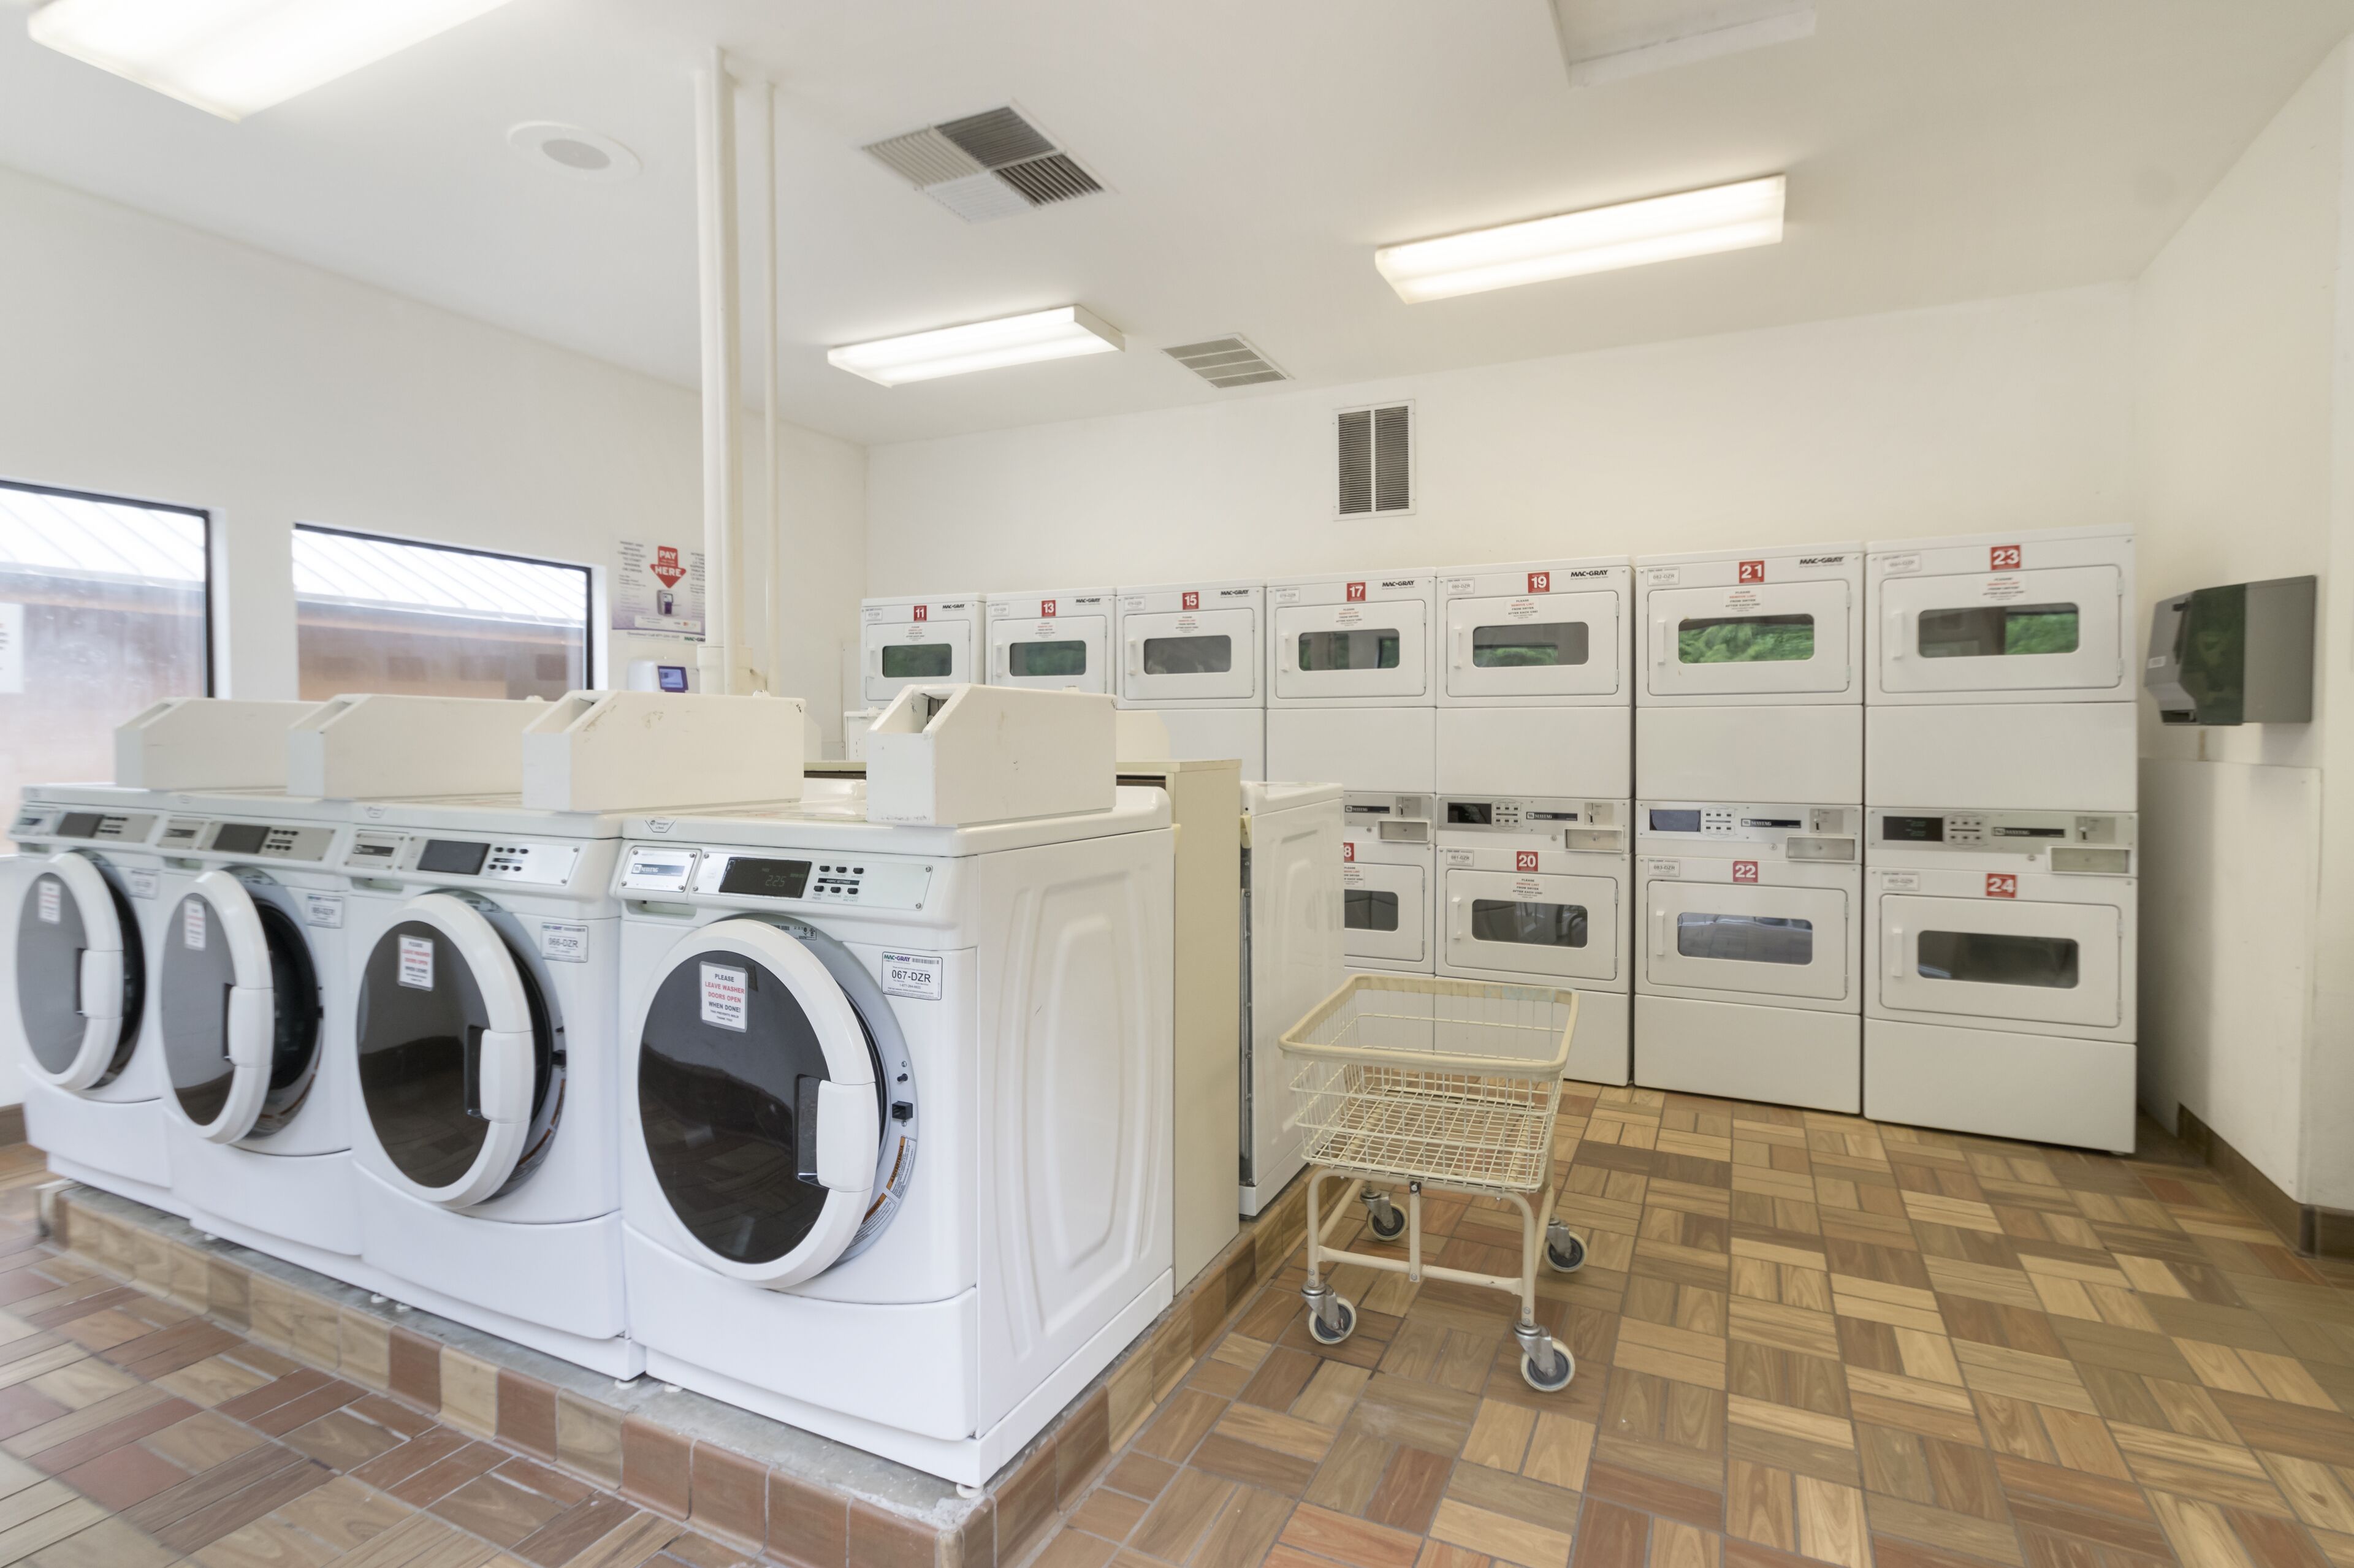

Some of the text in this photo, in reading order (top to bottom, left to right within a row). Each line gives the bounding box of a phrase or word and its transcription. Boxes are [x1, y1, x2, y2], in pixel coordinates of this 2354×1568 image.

[660, 550, 676, 559] PAY
[1992, 549, 2019, 565] 23
[655, 565, 682, 577] HERE
[1741, 564, 1762, 579] 21
[1531, 576, 1547, 588] 19
[1349, 586, 1364, 598] 17
[1184, 595, 1197, 606] 15
[915, 608, 924, 618] 11
[1043, 603, 1054, 613] 13
[1344, 846, 1352, 858] 8
[1518, 854, 1536, 867] 20
[1735, 865, 1756, 878] 22
[1988, 878, 2016, 893] 24
[715, 973, 734, 982] PLEASE
[892, 970, 931, 983] 067-DZR
[723, 985, 745, 994] WASHER
[708, 992, 725, 1000] DOORS
